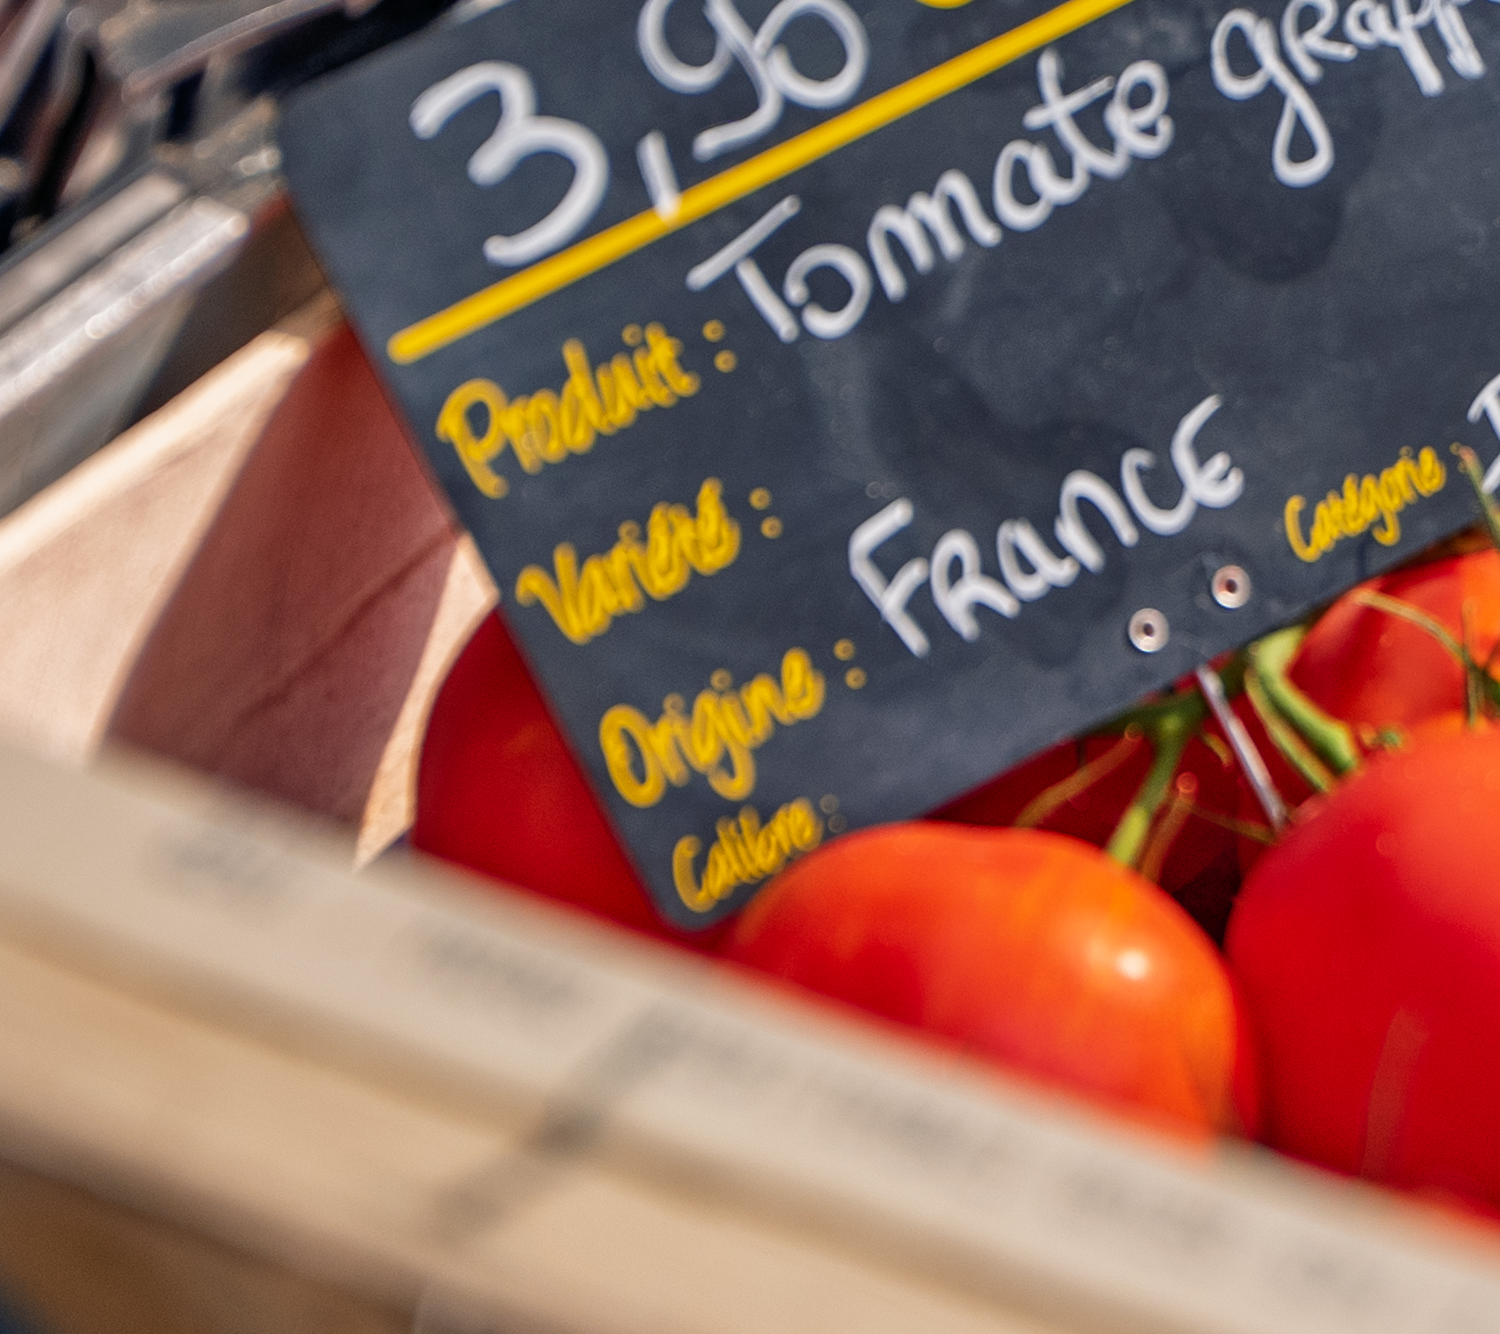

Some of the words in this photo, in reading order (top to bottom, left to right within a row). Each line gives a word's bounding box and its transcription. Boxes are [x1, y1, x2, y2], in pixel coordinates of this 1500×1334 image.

[435, 320, 700, 500] Produit
[685, 46, 1176, 343] Tomate
[600, 646, 822, 809] Origine
[671, 796, 824, 913] Calibre
